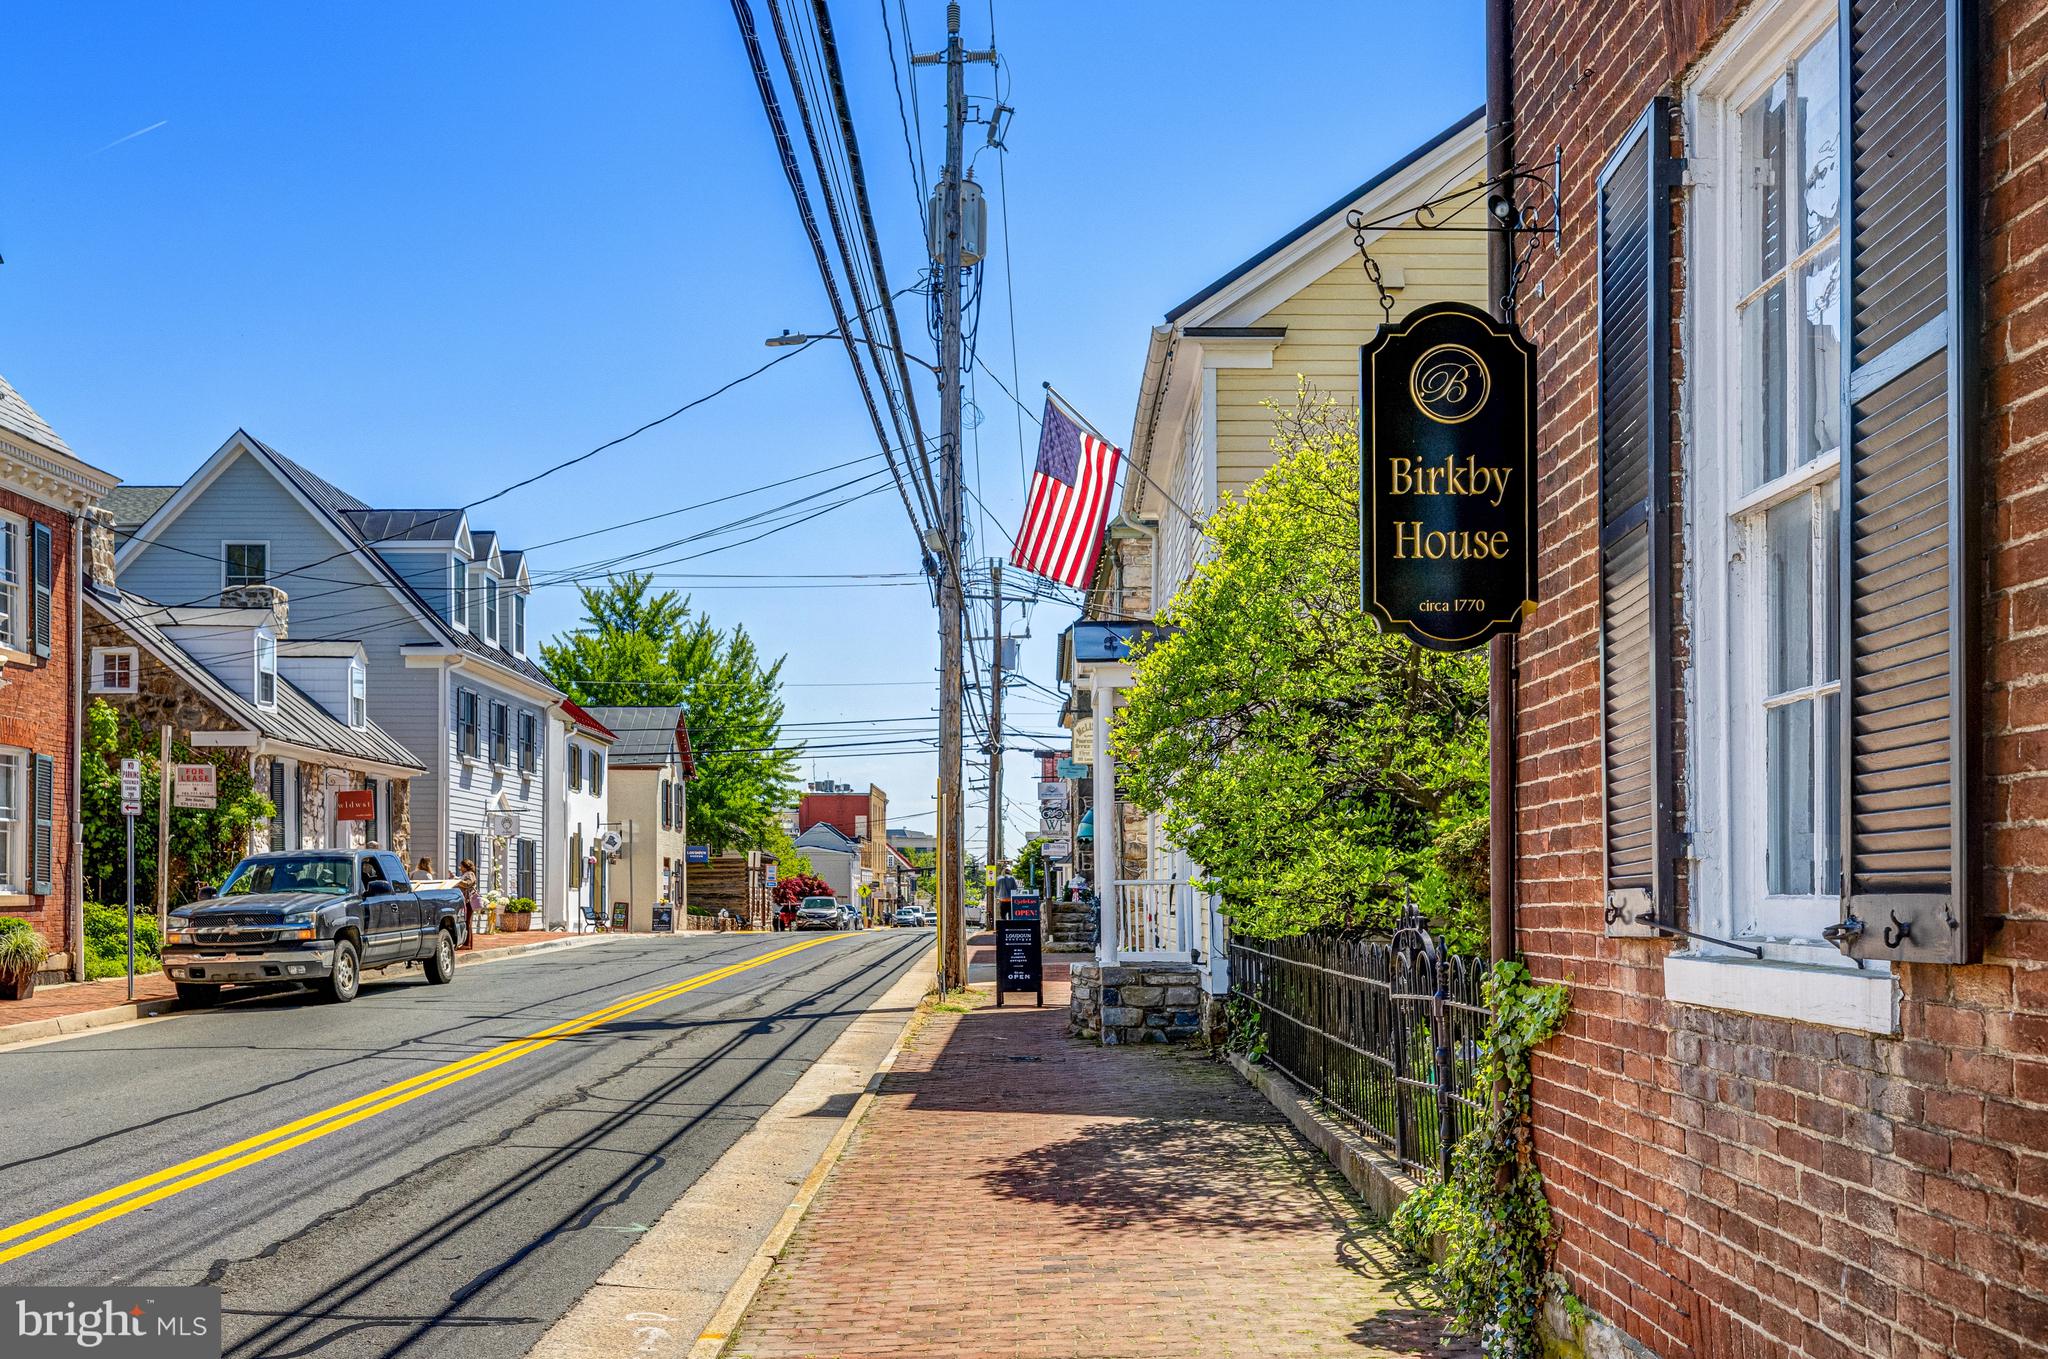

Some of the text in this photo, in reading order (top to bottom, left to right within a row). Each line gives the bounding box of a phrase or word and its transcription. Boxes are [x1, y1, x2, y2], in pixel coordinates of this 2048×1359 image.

[1388, 453, 1514, 507] Birkby
[1393, 521, 1510, 560] House
[1419, 599, 1485, 612] circa 1770
